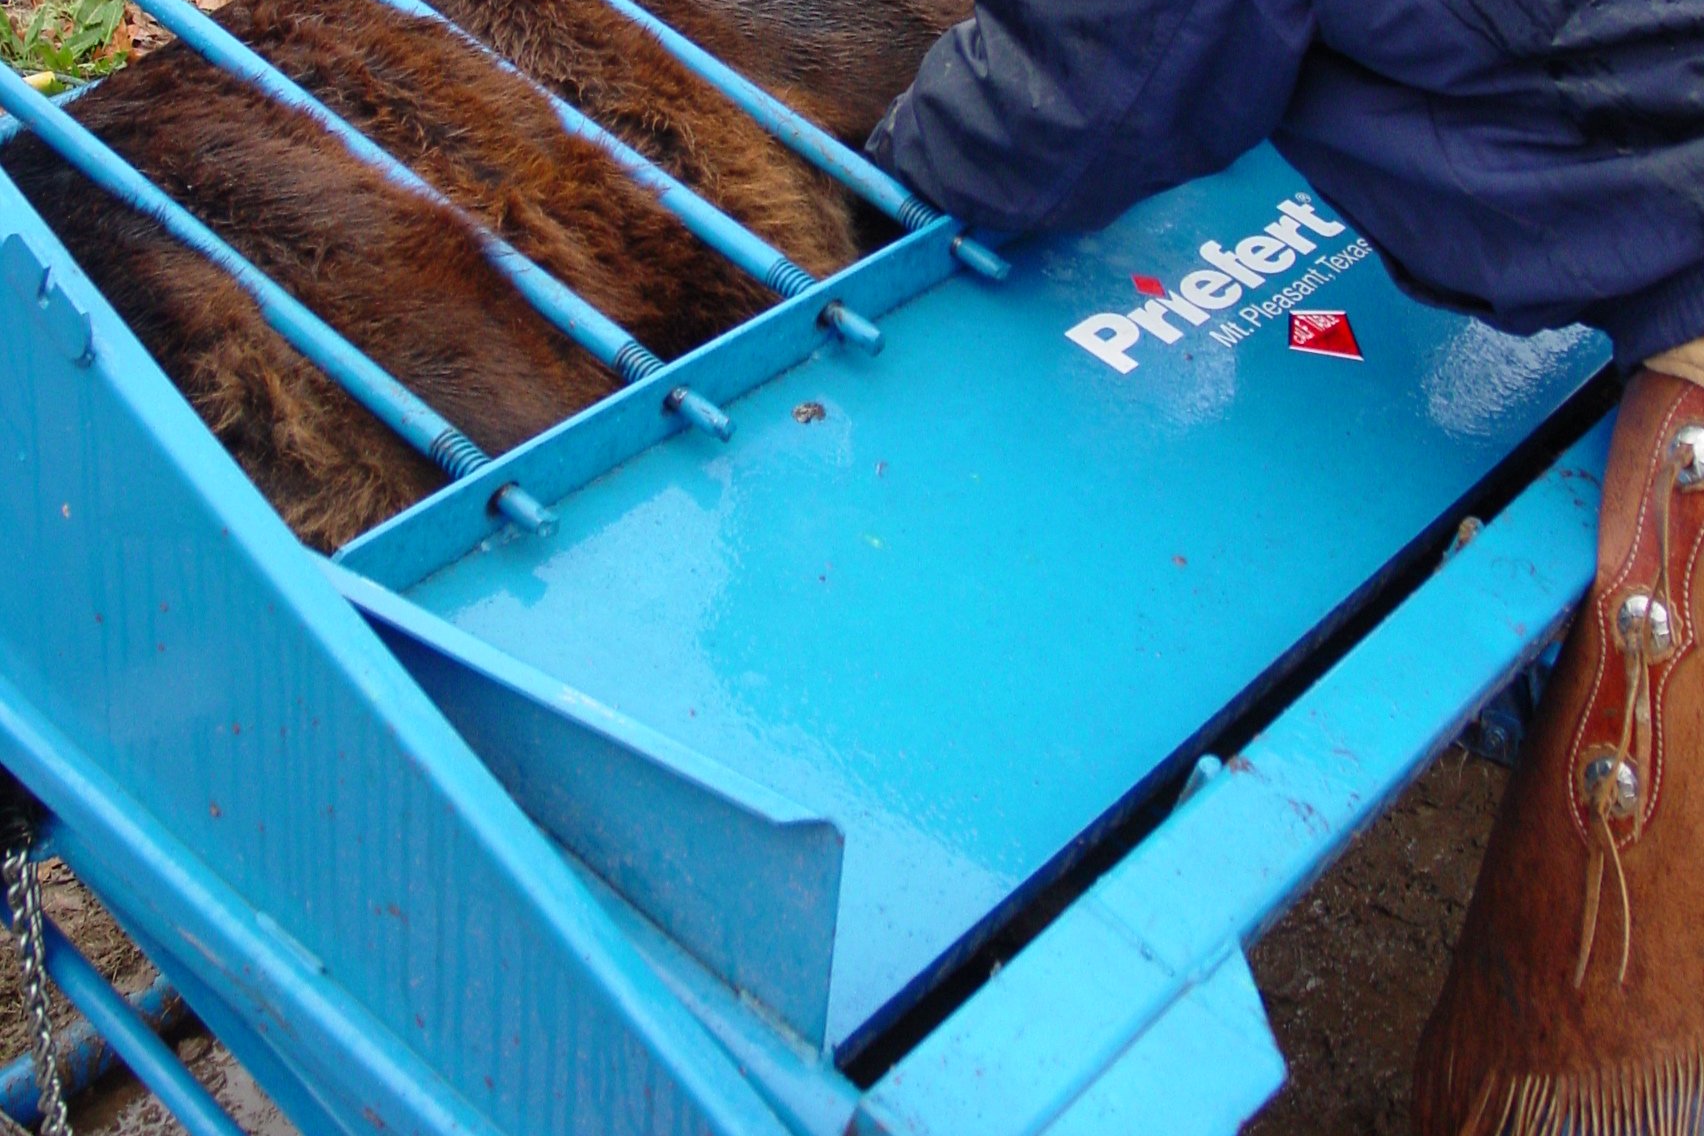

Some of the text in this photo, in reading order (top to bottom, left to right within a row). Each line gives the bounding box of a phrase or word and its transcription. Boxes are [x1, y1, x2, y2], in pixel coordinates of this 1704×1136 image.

[1065, 199, 1346, 374] Priefert
[1209, 323, 1255, 348] Mt.
[1315, 237, 1373, 277] Texas
